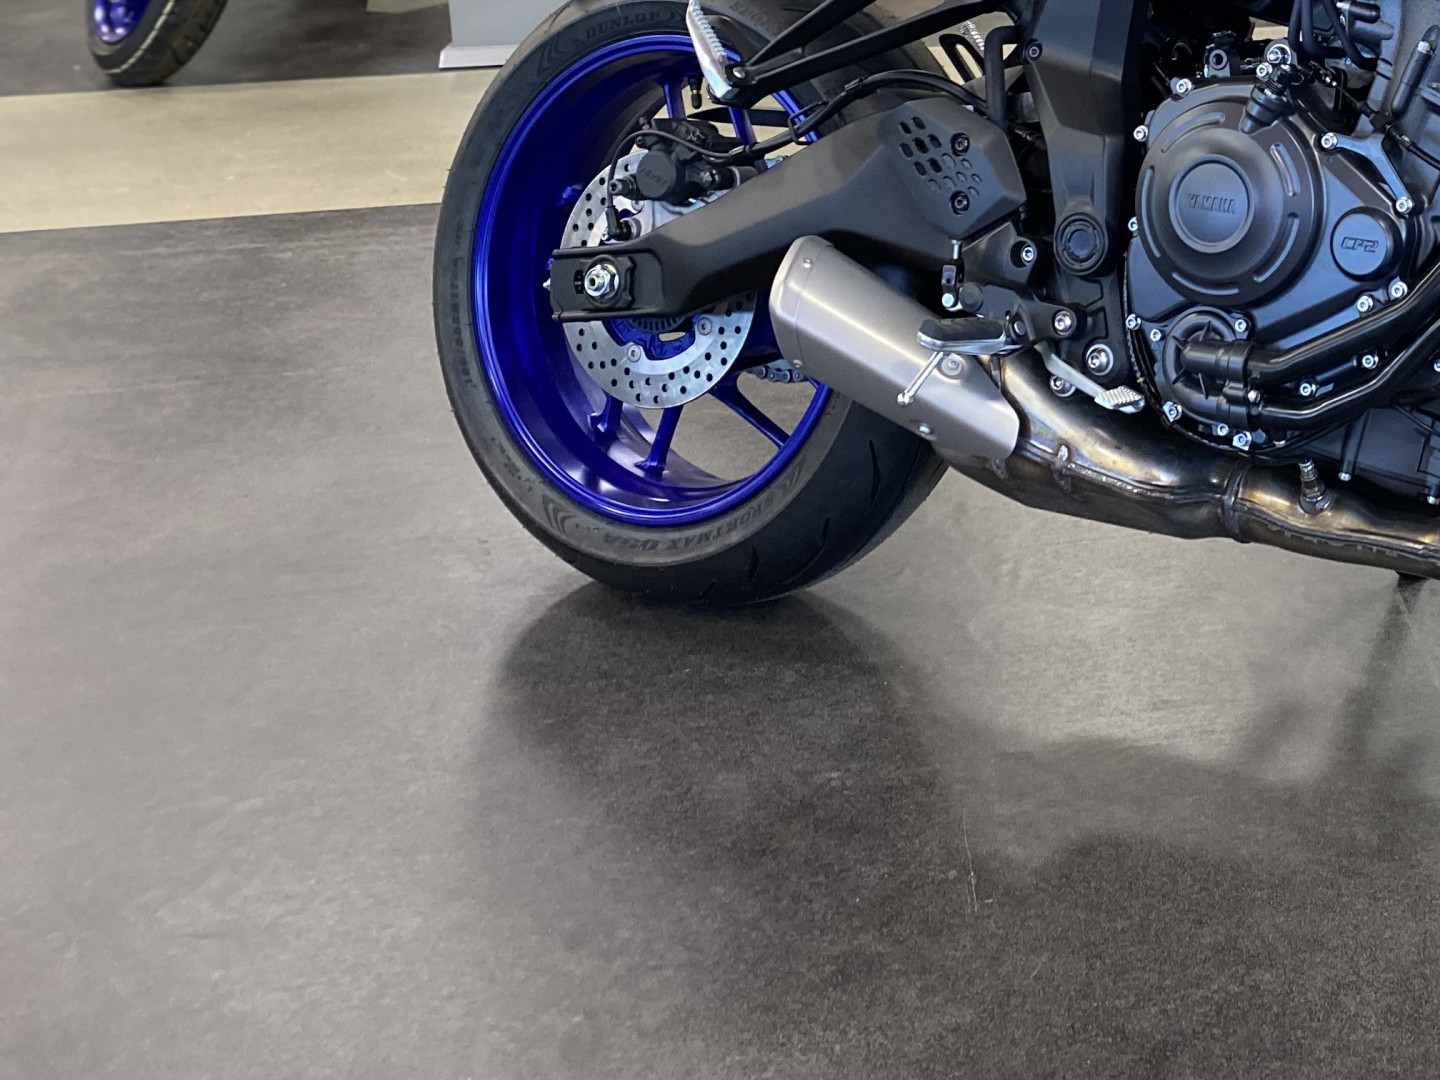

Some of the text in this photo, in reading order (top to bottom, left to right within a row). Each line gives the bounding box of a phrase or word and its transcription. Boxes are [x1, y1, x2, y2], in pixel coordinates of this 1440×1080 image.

[585, 11, 661, 39] DUNLOP
[1187, 192, 1237, 215] YAMAHA
[1340, 236, 1379, 253] CP2
